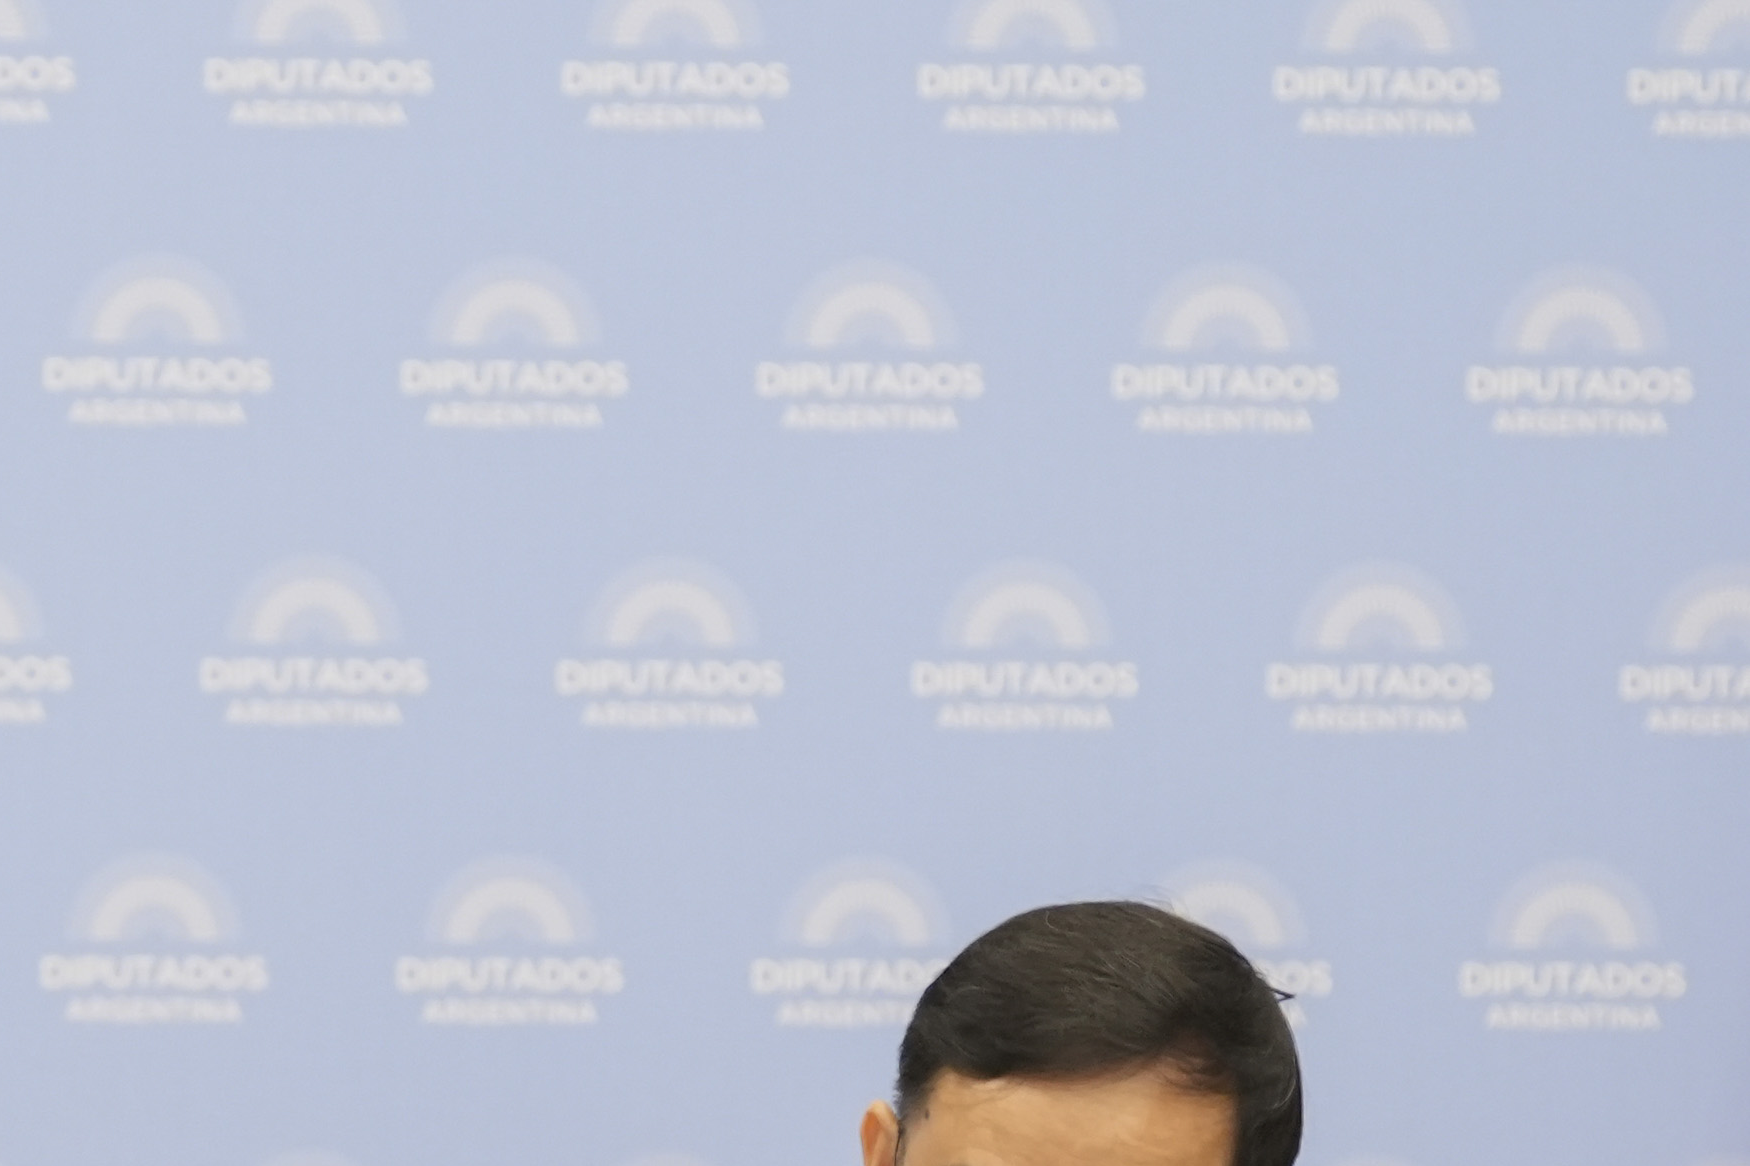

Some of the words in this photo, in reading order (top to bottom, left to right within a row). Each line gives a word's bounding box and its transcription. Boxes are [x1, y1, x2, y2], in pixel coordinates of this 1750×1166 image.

[204, 59, 432, 94] DIPUTADOS
[561, 62, 790, 97] DIPUTADOS
[916, 65, 1145, 100] DIPUTADOS
[1274, 67, 1502, 101] DIPUTADOS
[1626, 69, 1750, 104] DIPUT
[42, 358, 272, 391] DIPUTADOS
[400, 361, 629, 397] DIPUTADOS
[755, 363, 983, 399] DIPUTADOS
[1111, 365, 1339, 399] DIPUTADOS
[1466, 368, 1693, 403] DIPUTADOS
[200, 659, 429, 694] DIPUTADOS
[555, 660, 784, 696] DIPUTADOS
[912, 662, 1138, 697] DIPUTADOS
[1266, 664, 1493, 702] DIPUTADOS
[40, 955, 269, 991] DIPUTADOS
[395, 958, 623, 993] DIPUTADOS
[1460, 963, 1687, 997] DIPUTADOS
